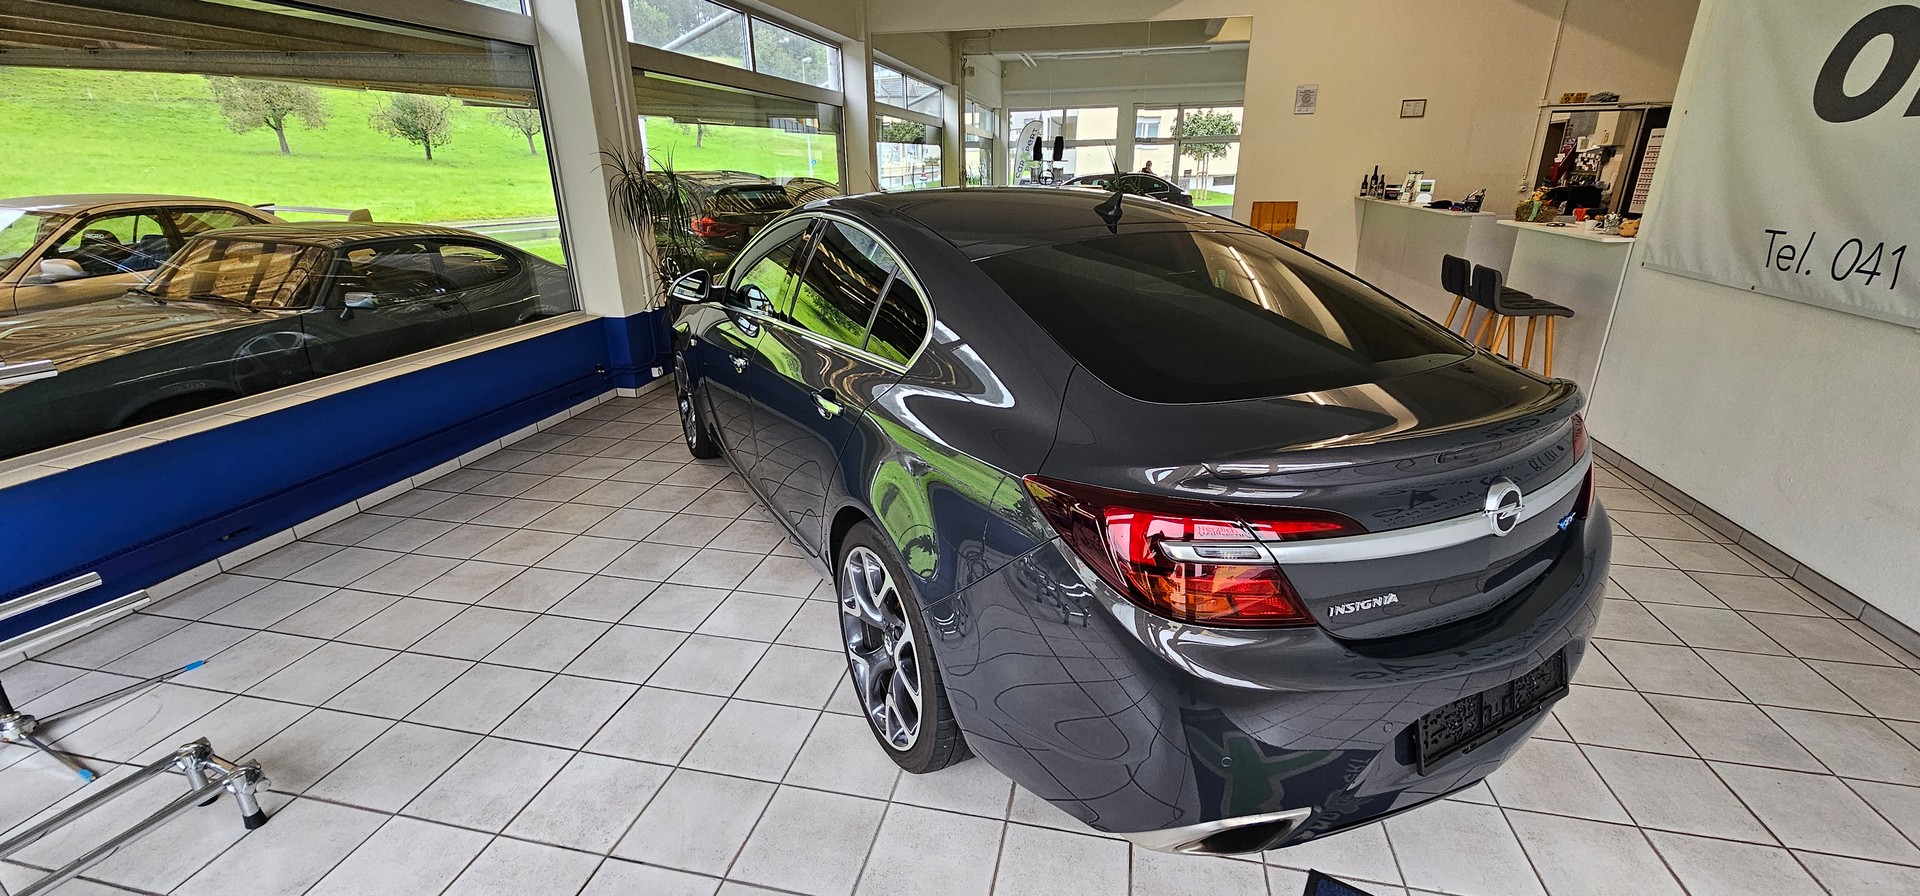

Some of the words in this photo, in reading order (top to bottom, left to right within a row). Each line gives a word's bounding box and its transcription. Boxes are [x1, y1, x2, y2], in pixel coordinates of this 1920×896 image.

[1813, 4, 1920, 123] O
[1765, 229, 1816, 276] Tel.
[1831, 238, 1907, 290] 041
[1328, 592, 1399, 617] INSIGNIA
